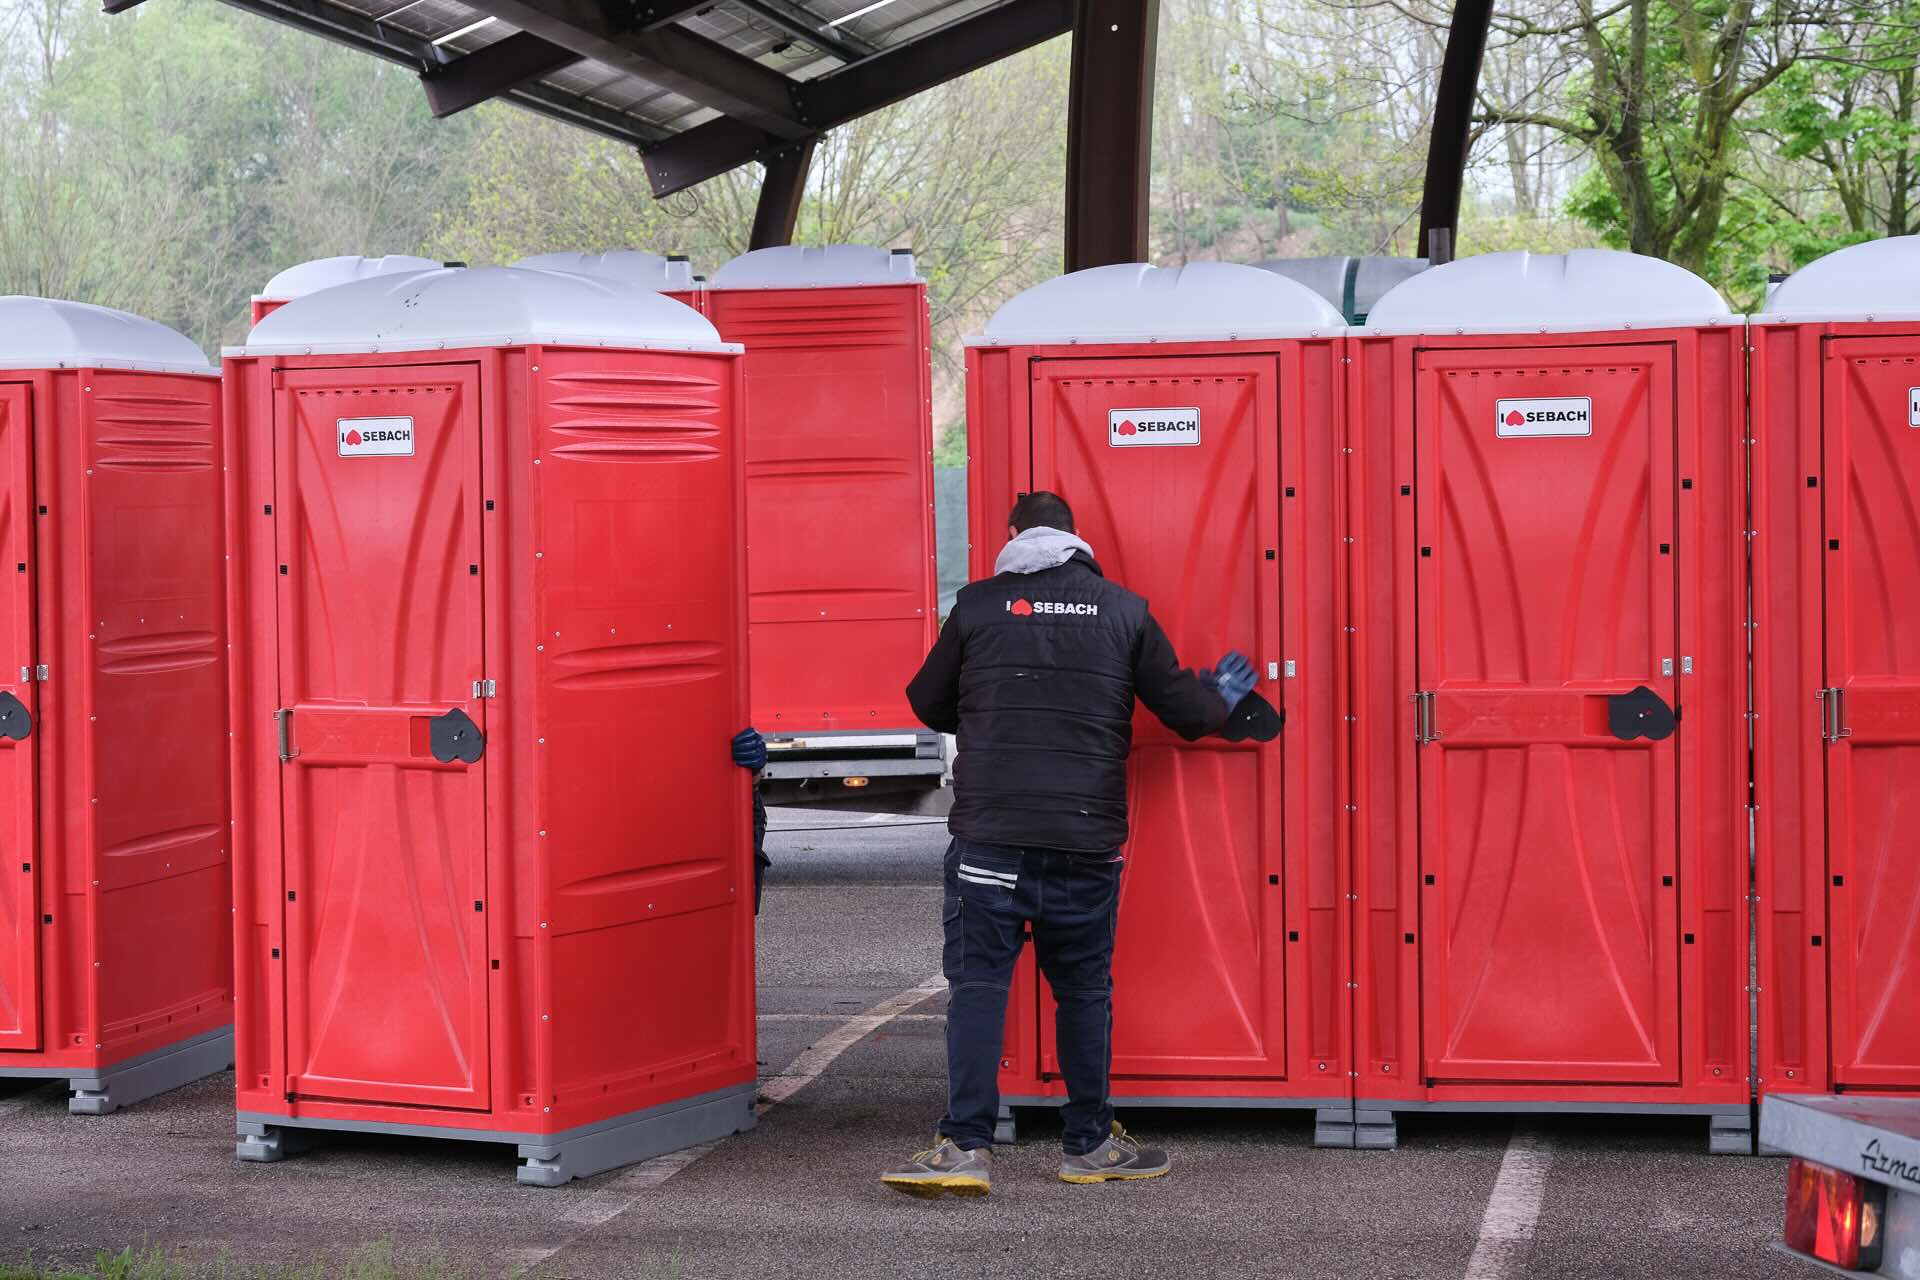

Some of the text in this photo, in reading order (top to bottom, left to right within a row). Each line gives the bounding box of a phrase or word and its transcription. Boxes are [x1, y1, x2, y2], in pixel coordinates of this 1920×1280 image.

[1500, 410, 1587, 423] I SEBACH
[1113, 421, 1196, 432] I SEBACH
[341, 430, 411, 442] I SEBACH
[1006, 601, 1098, 615] I SEBACH
